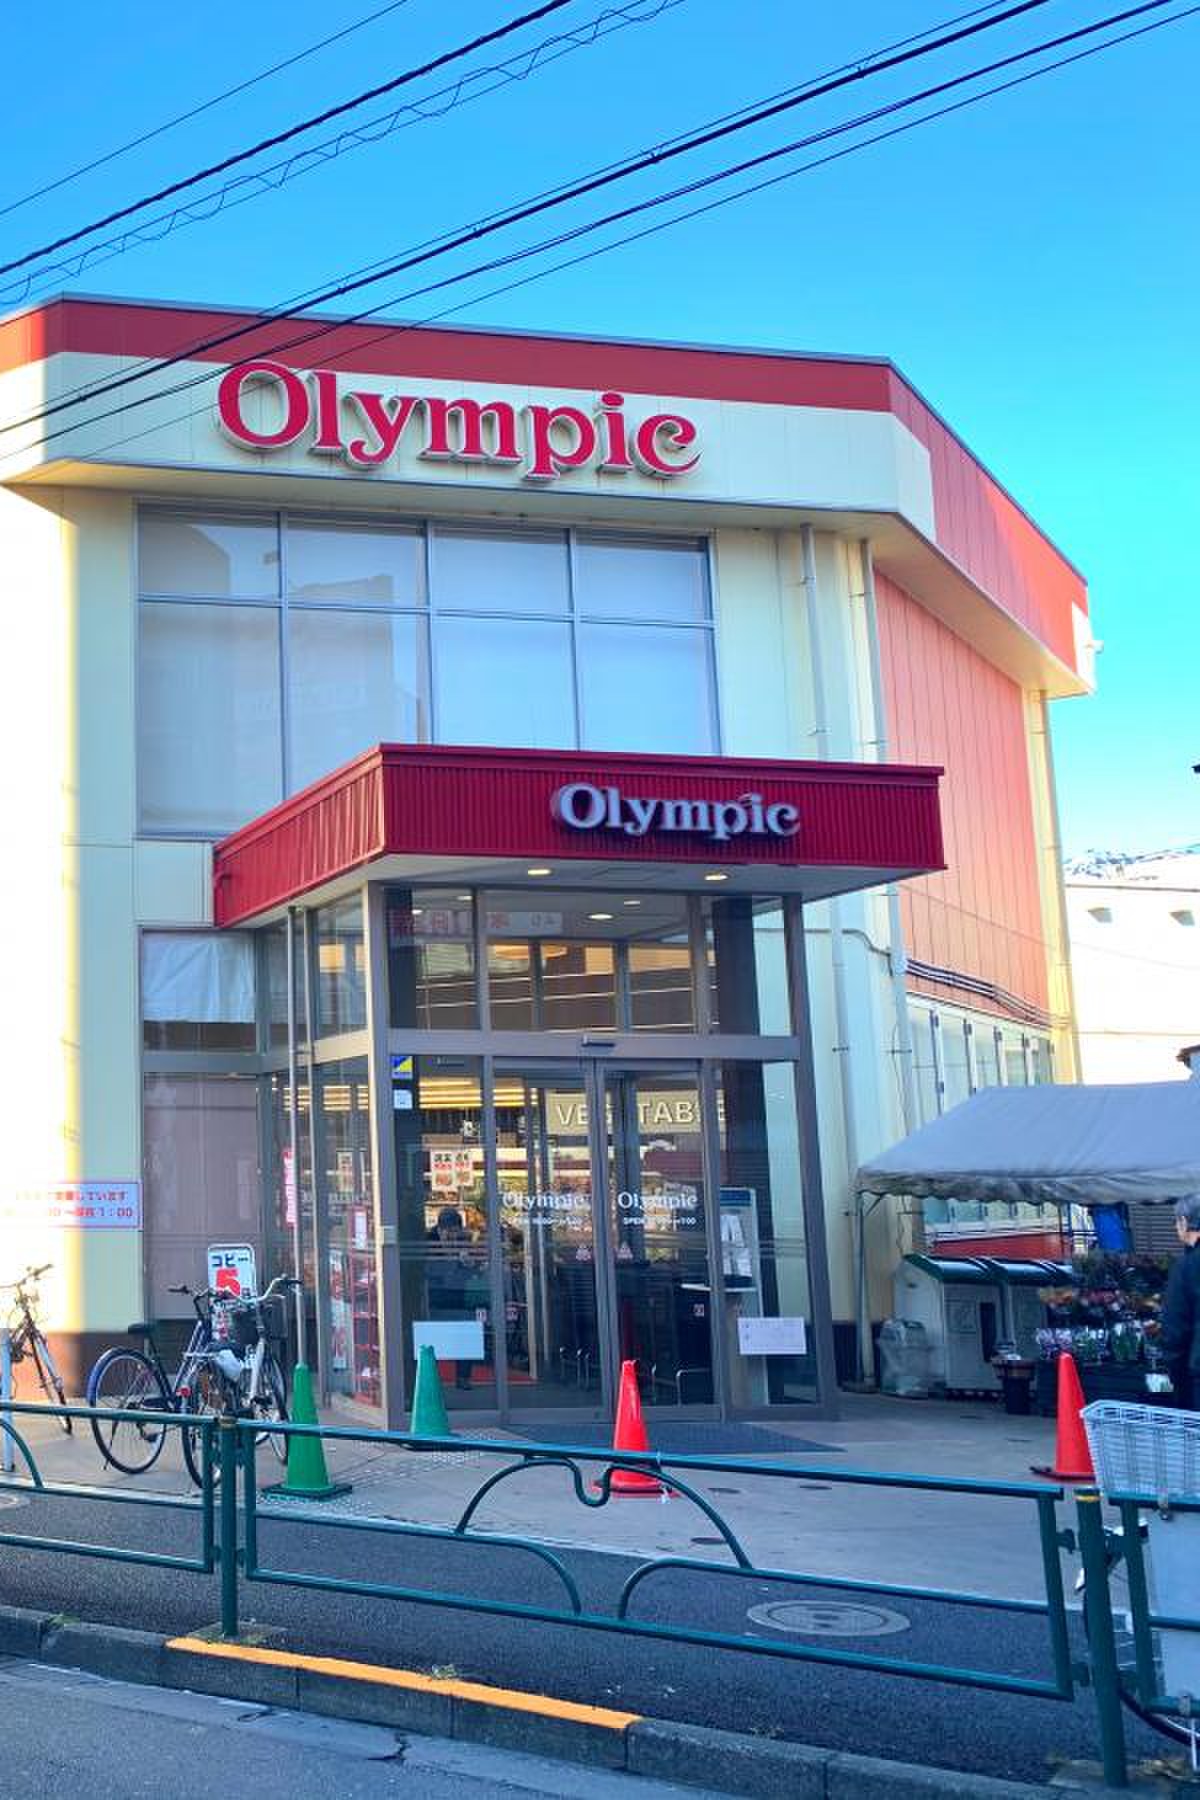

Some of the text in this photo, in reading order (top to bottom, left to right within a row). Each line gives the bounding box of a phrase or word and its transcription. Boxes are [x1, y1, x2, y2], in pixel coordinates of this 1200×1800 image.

[217, 360, 704, 481] Olympic
[552, 782, 801, 840] Olympic
[211, 1253, 249, 1267] コピー
